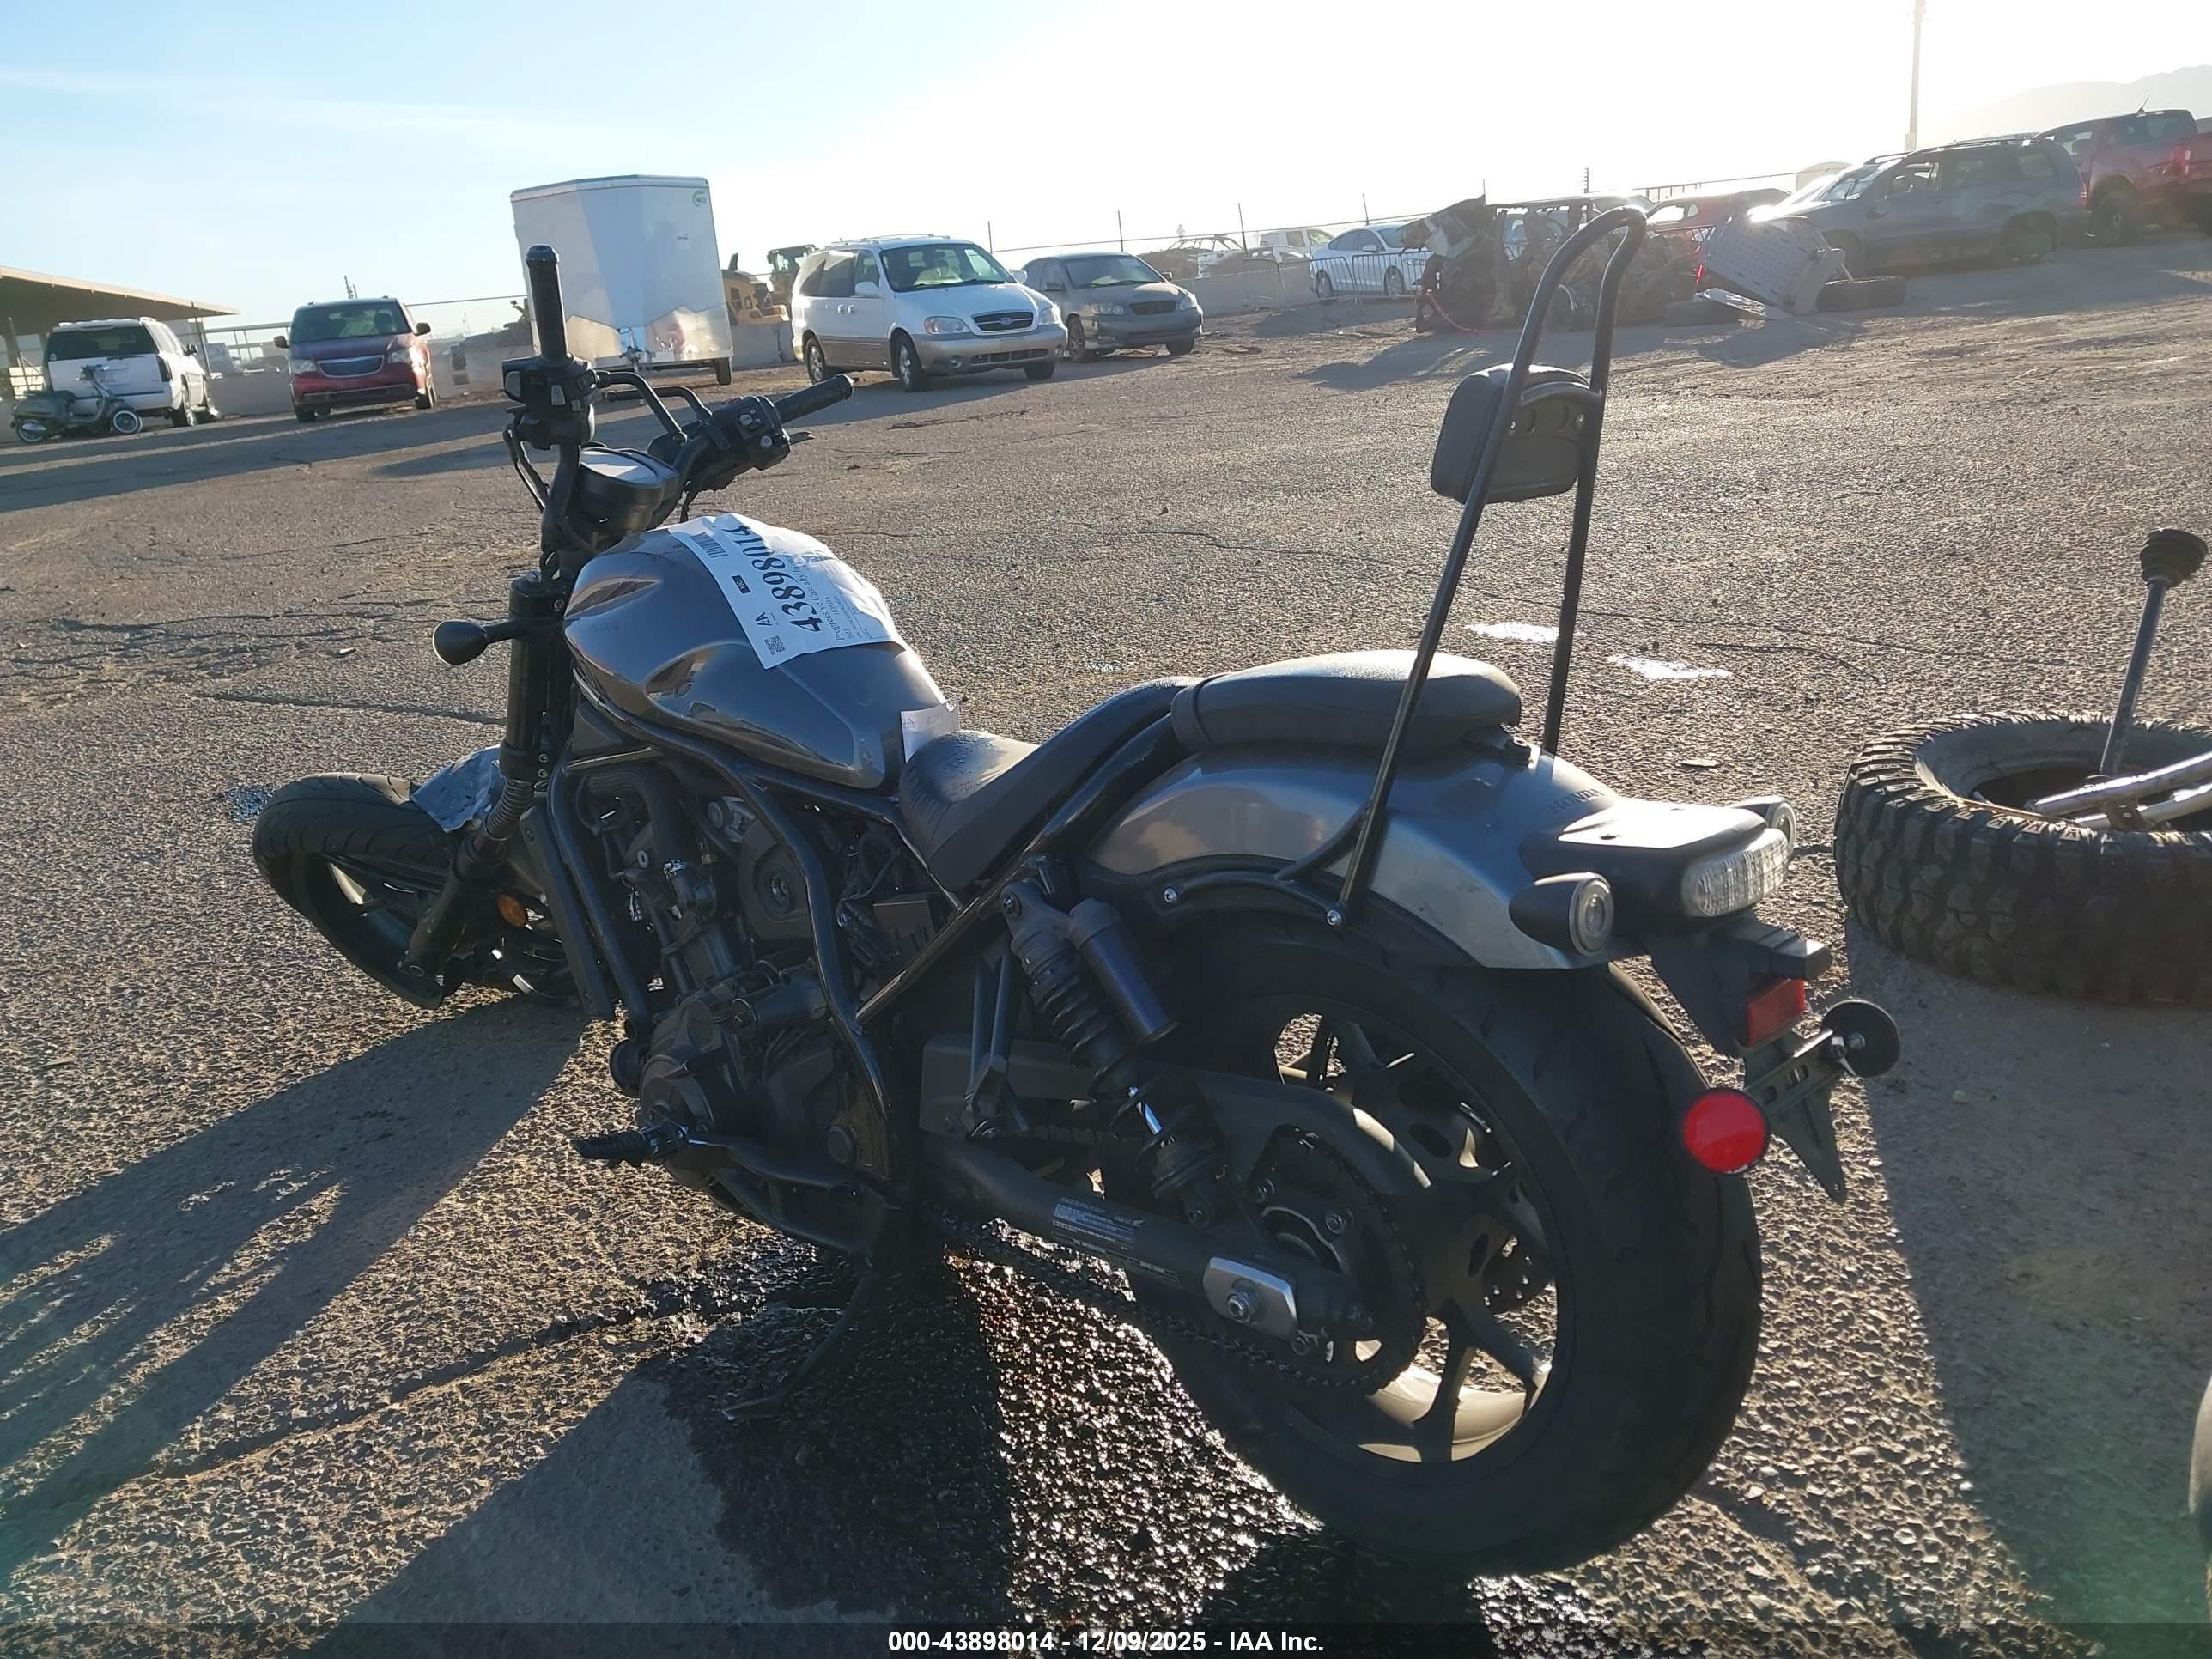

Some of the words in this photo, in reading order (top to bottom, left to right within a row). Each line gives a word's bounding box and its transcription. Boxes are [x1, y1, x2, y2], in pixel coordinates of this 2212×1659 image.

[721, 526, 823, 632] 43898014
[817, 600, 846, 641] Progressive
[1547, 788, 1605, 815] HONDA
